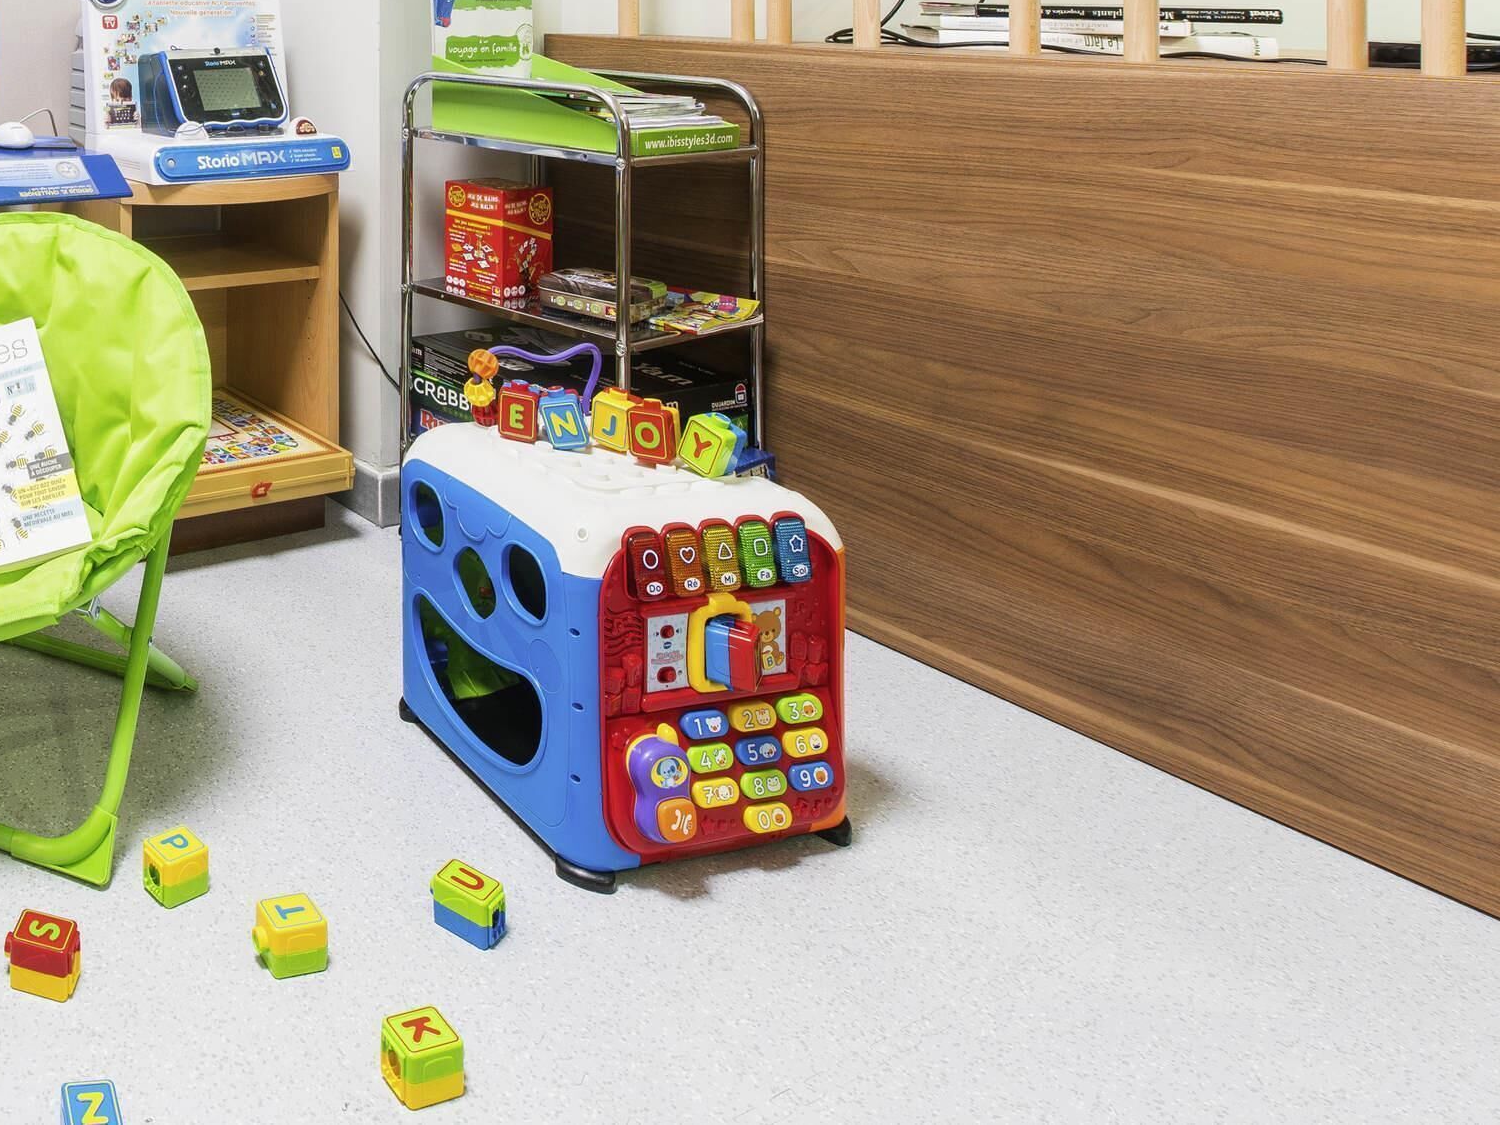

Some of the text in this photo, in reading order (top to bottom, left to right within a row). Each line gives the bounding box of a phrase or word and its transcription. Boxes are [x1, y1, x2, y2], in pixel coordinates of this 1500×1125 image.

[1091, 8, 1123, 19] plants
[448, 47, 479, 59] voyage
[491, 43, 517, 56] famille
[644, 133, 733, 150] www.ibisstyles3d.com
[196, 154, 238, 170] Storio
[242, 149, 286, 166] MAX
[413, 377, 473, 411] CRABB
[724, 573, 735, 583] Mi
[760, 570, 771, 580] Fa
[793, 565, 807, 576] Sol
[649, 583, 662, 593] Do
[686, 579, 699, 589] Ré
[767, 657, 774, 667] B
[694, 702, 800, 736] 1 2 3
[699, 735, 807, 769] 4 5 6
[703, 769, 811, 805] 7 8 9
[758, 811, 770, 829] 0
[161, 833, 189, 850] P
[450, 866, 485, 891] U
[274, 902, 306, 921] T
[28, 919, 61, 942] S
[401, 1016, 442, 1044] K
